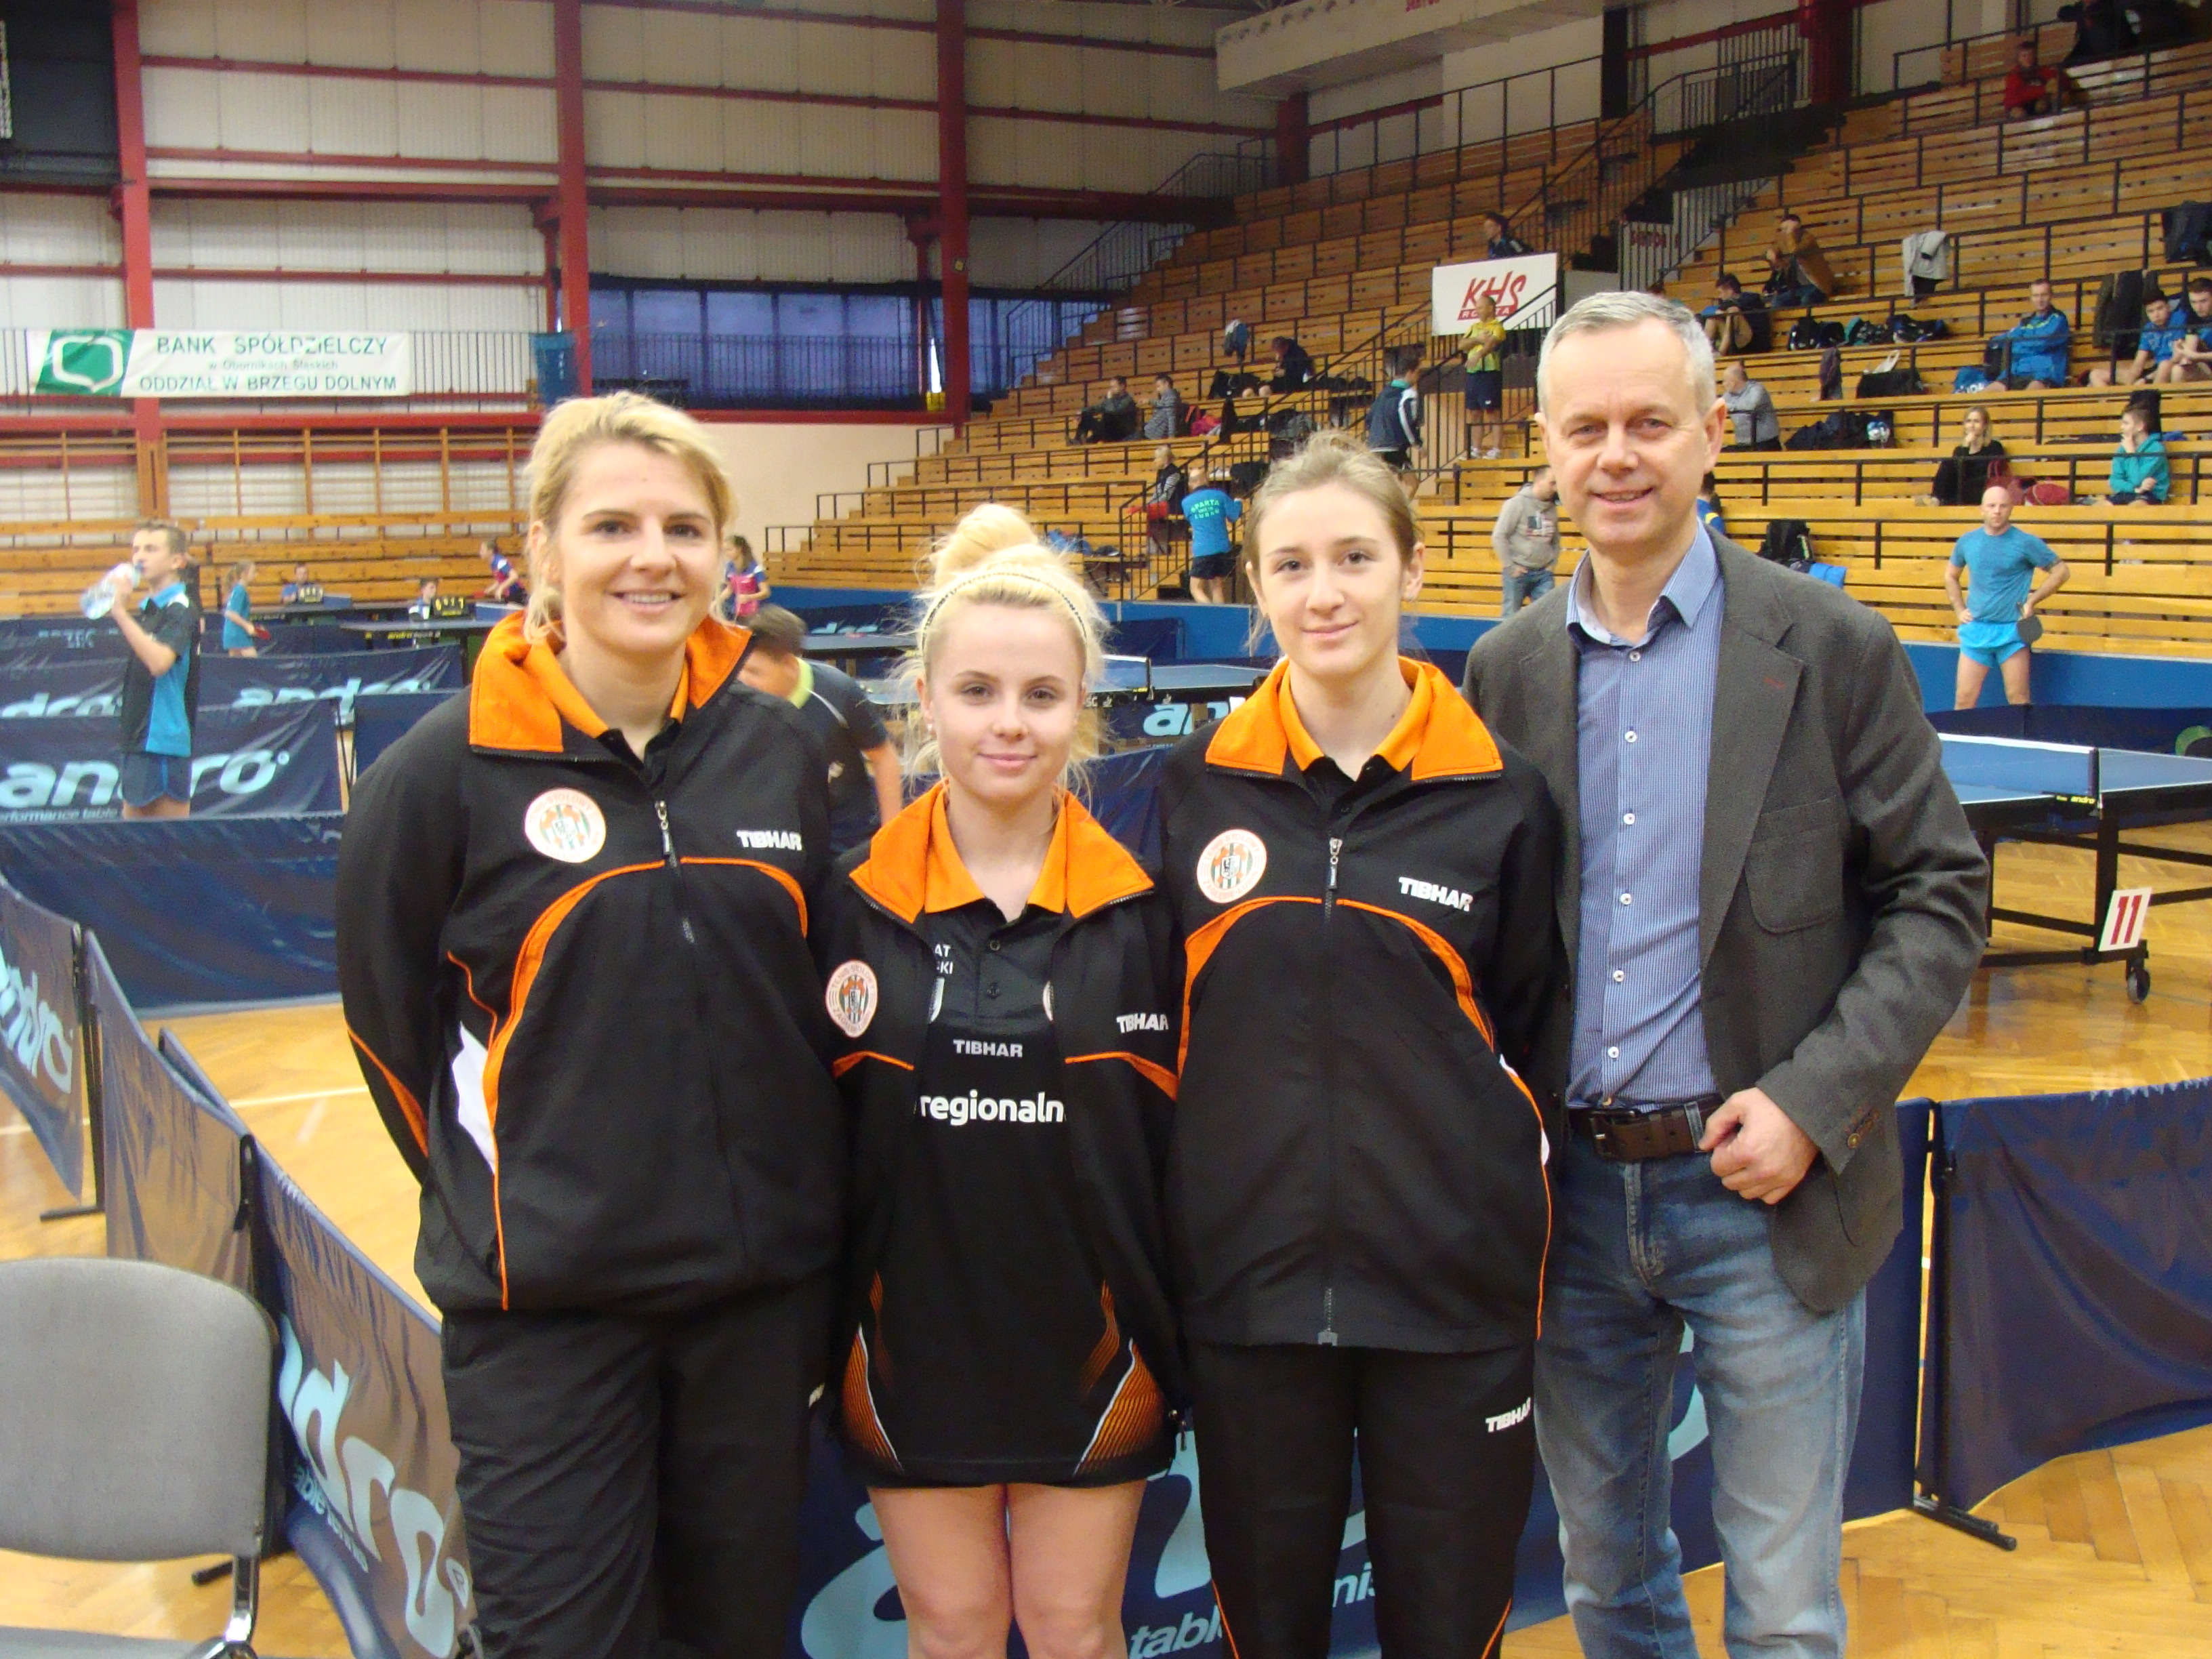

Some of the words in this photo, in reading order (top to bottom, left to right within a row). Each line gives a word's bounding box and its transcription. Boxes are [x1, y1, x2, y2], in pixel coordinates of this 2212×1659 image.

[1462, 270, 1527, 310] KHS
[157, 337, 216, 354] BANK
[234, 333, 387, 354] SPÓŁDZIELCZY
[222, 375, 239, 390] W
[247, 375, 318, 391] BRZEGU
[325, 375, 397, 391] DOLNYM
[0, 749, 278, 809] anro
[737, 830, 802, 851] TIBHAR
[1398, 877, 1474, 912] TIBHAR
[2110, 894, 2143, 946] 11
[953, 1039, 1023, 1059] TIBHAR
[1485, 1396, 1532, 1433] TIBHA
